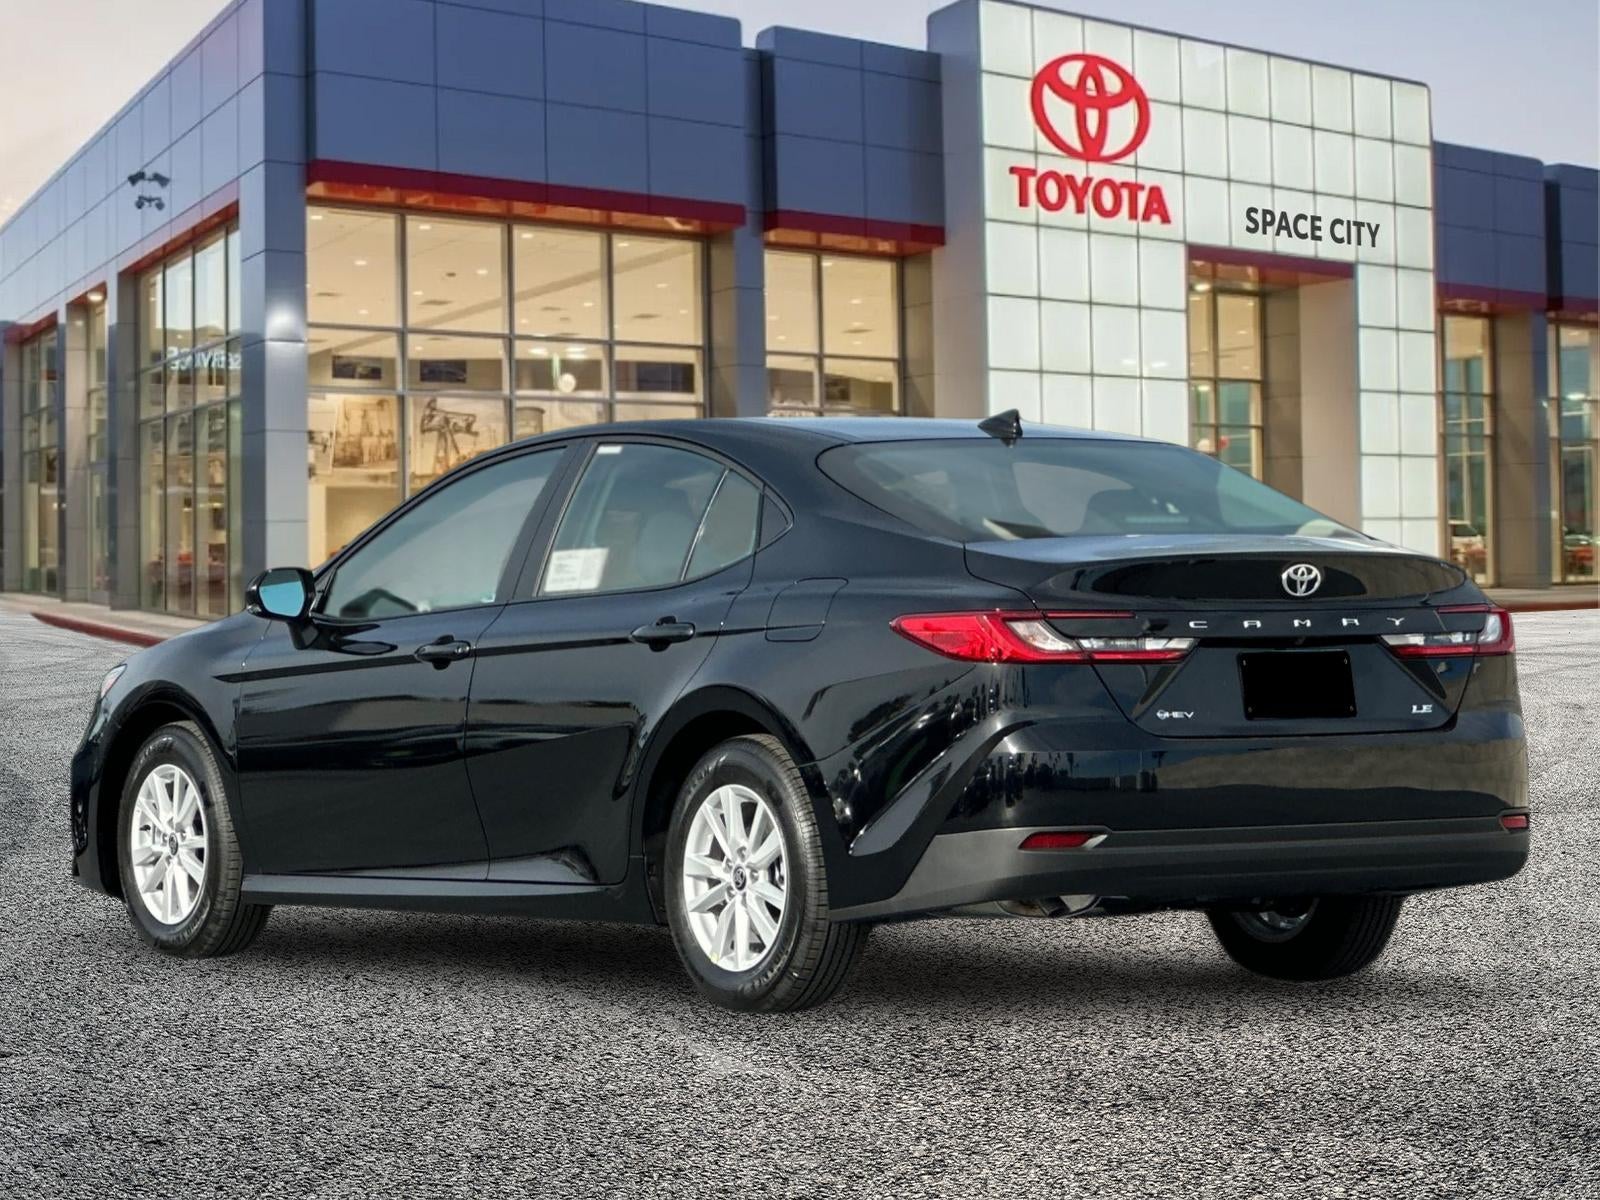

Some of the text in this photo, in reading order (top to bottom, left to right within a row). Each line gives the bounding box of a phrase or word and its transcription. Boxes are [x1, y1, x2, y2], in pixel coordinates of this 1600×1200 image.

[1009, 166, 1171, 224] TOYOTA
[1245, 207, 1380, 248] SPACE CITY
[1189, 616, 1405, 629] CAMRY
[1166, 711, 1194, 719] HEV
[1411, 704, 1433, 714] LE
